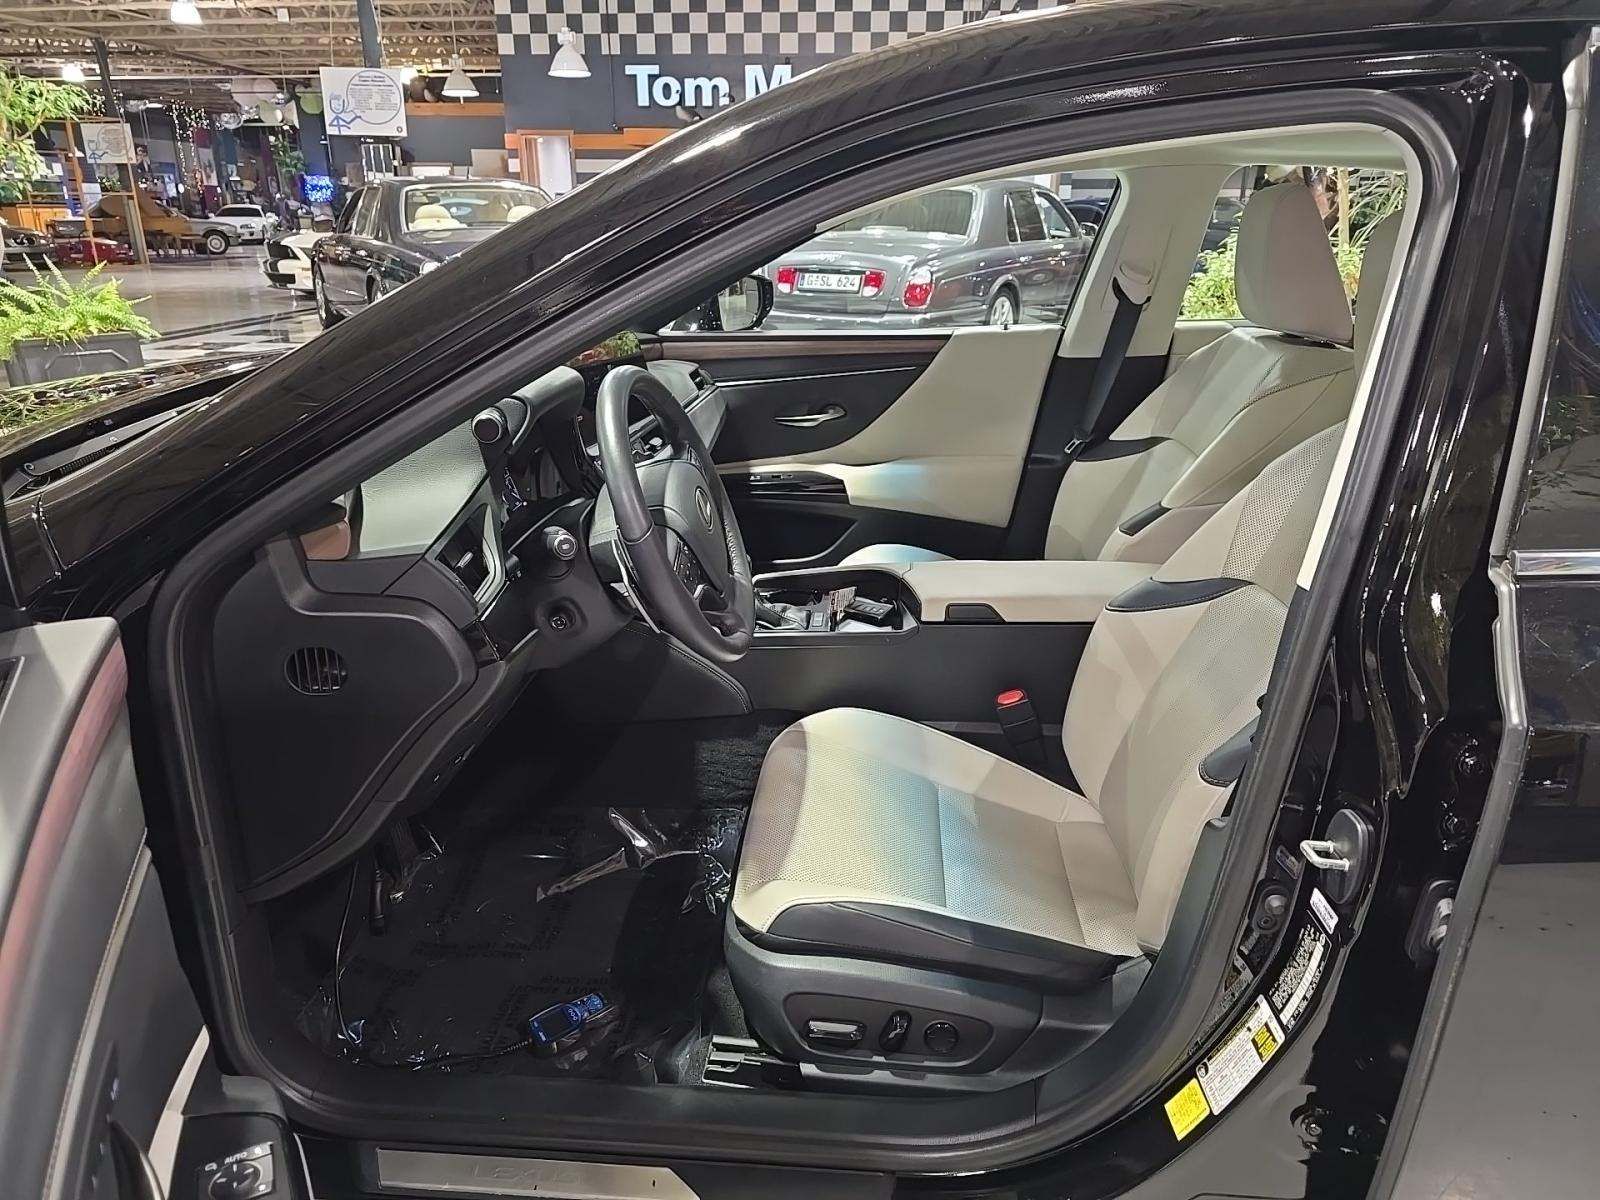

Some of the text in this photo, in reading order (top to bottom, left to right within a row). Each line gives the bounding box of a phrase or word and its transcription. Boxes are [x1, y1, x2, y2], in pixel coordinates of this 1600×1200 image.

[624, 64, 730, 107] Tom
[837, 276, 856, 287] 624
[224, 1151, 248, 1165] AUTO
